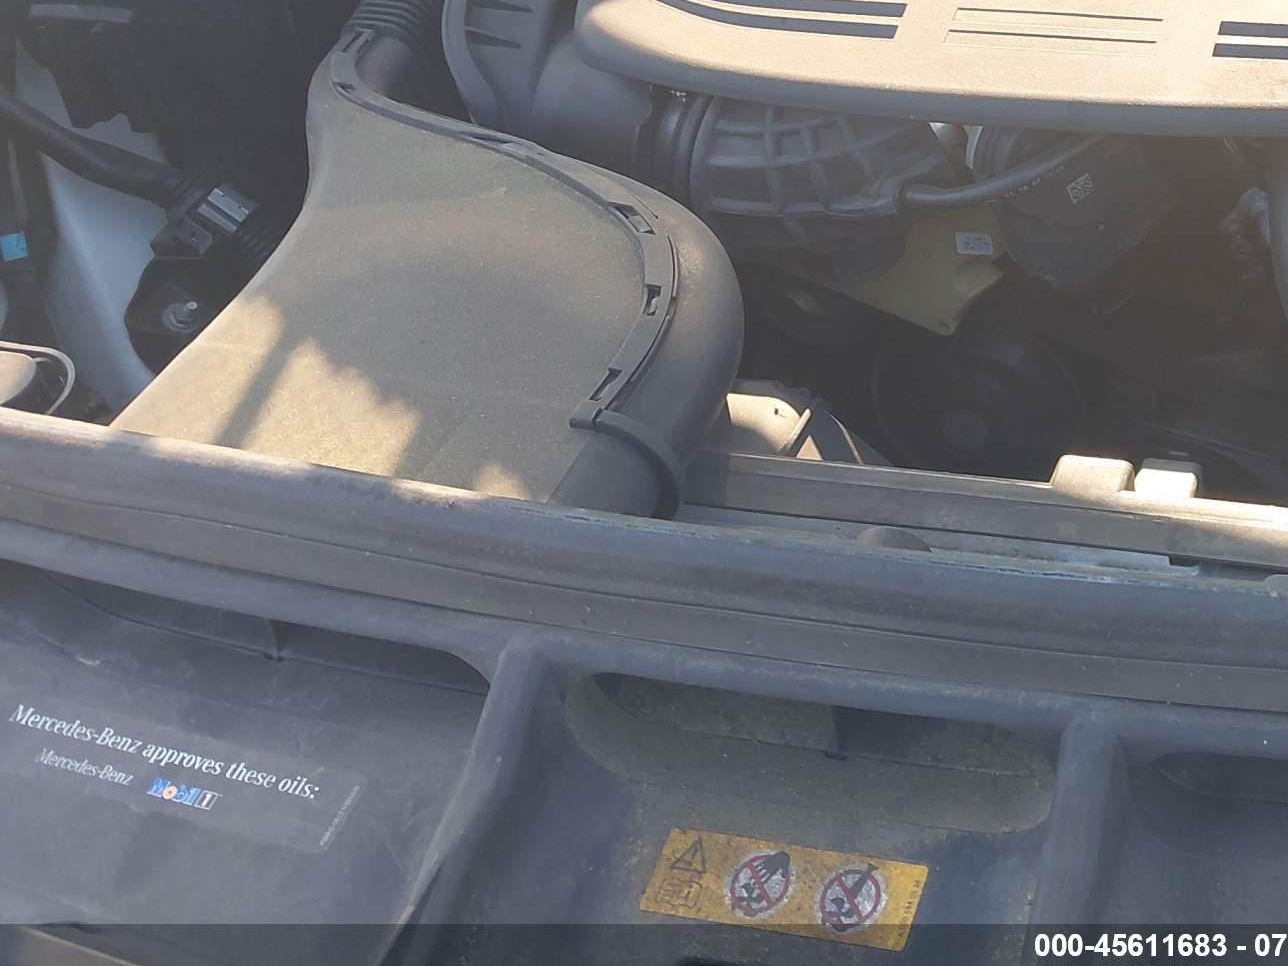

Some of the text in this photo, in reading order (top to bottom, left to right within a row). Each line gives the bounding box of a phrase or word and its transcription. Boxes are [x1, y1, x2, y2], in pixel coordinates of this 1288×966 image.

[9, 704, 319, 799] Mercedes-Benz approves these oils:
[35, 747, 135, 786] Mercedes-Benz
